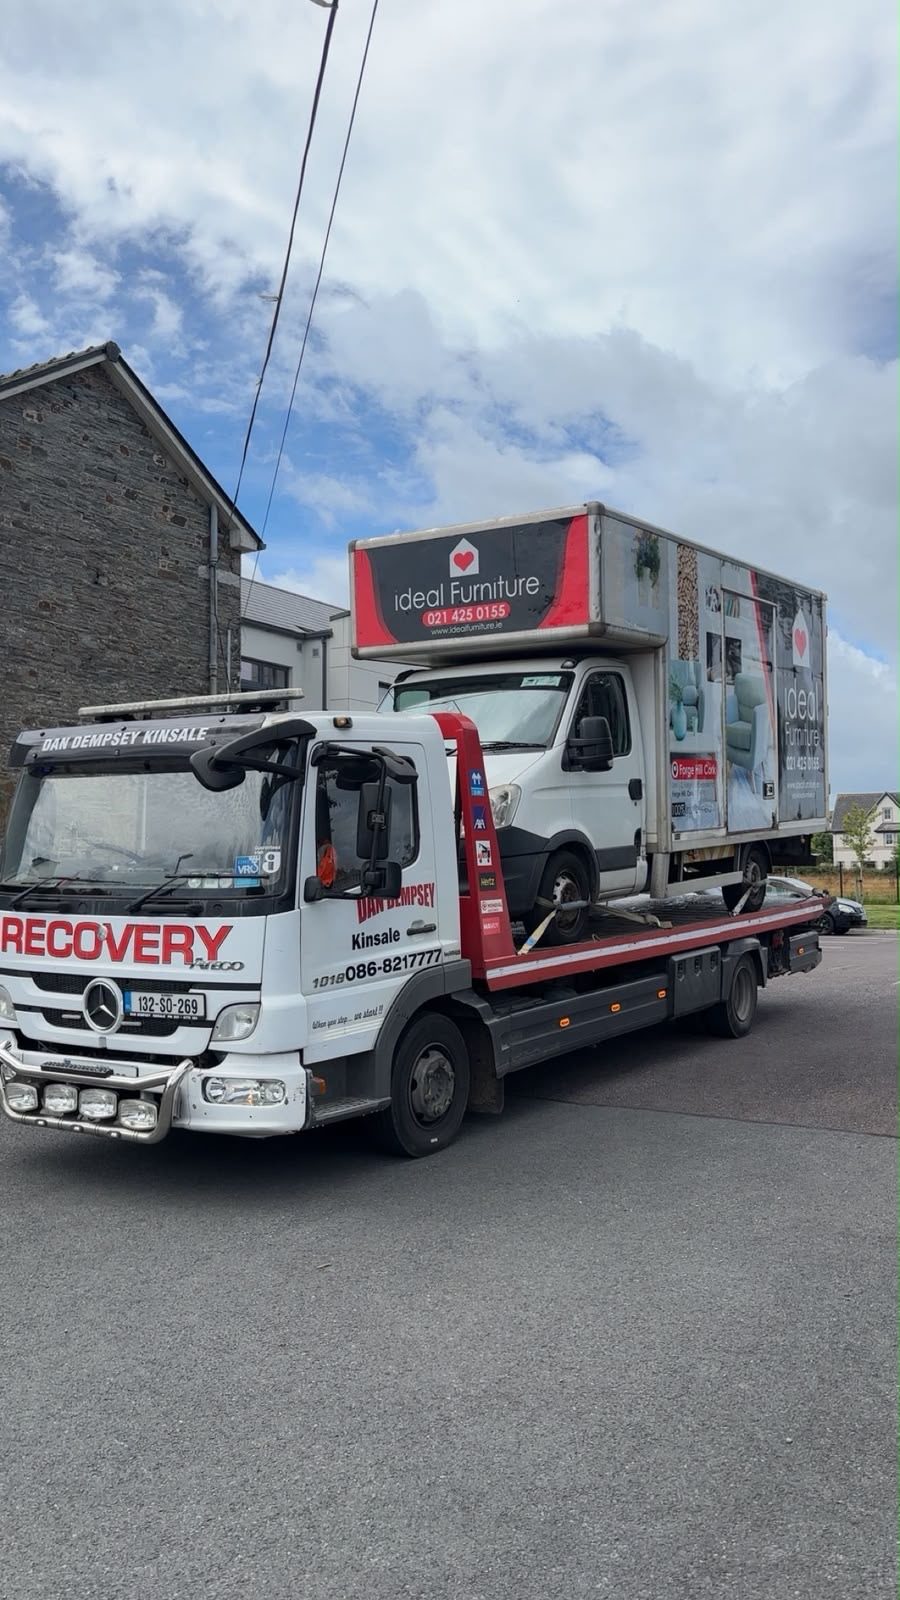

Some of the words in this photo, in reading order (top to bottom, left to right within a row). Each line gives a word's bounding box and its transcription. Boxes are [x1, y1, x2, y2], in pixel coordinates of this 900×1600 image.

[394, 583, 444, 611] ideal
[450, 576, 540, 605] Furniture
[427, 612, 447, 625] 021
[451, 609, 473, 622] 425
[476, 604, 506, 619] 0155
[431, 621, 503, 635] www.idealfurniture.ie
[784, 678, 819, 721] ideal
[42, 738, 70, 751] DAN
[71, 731, 142, 749] DEMPSEY
[142, 727, 209, 744] KINSALE
[785, 721, 820, 747] Furniture
[680, 764, 695, 778] Forge
[357, 897, 384, 924] DAN
[2, 917, 233, 966] RECOVERY
[352, 928, 400, 950] Kinsale
[345, 949, 442, 981] 086-8217777
[138, 996, 198, 1014] 132-SO-269
